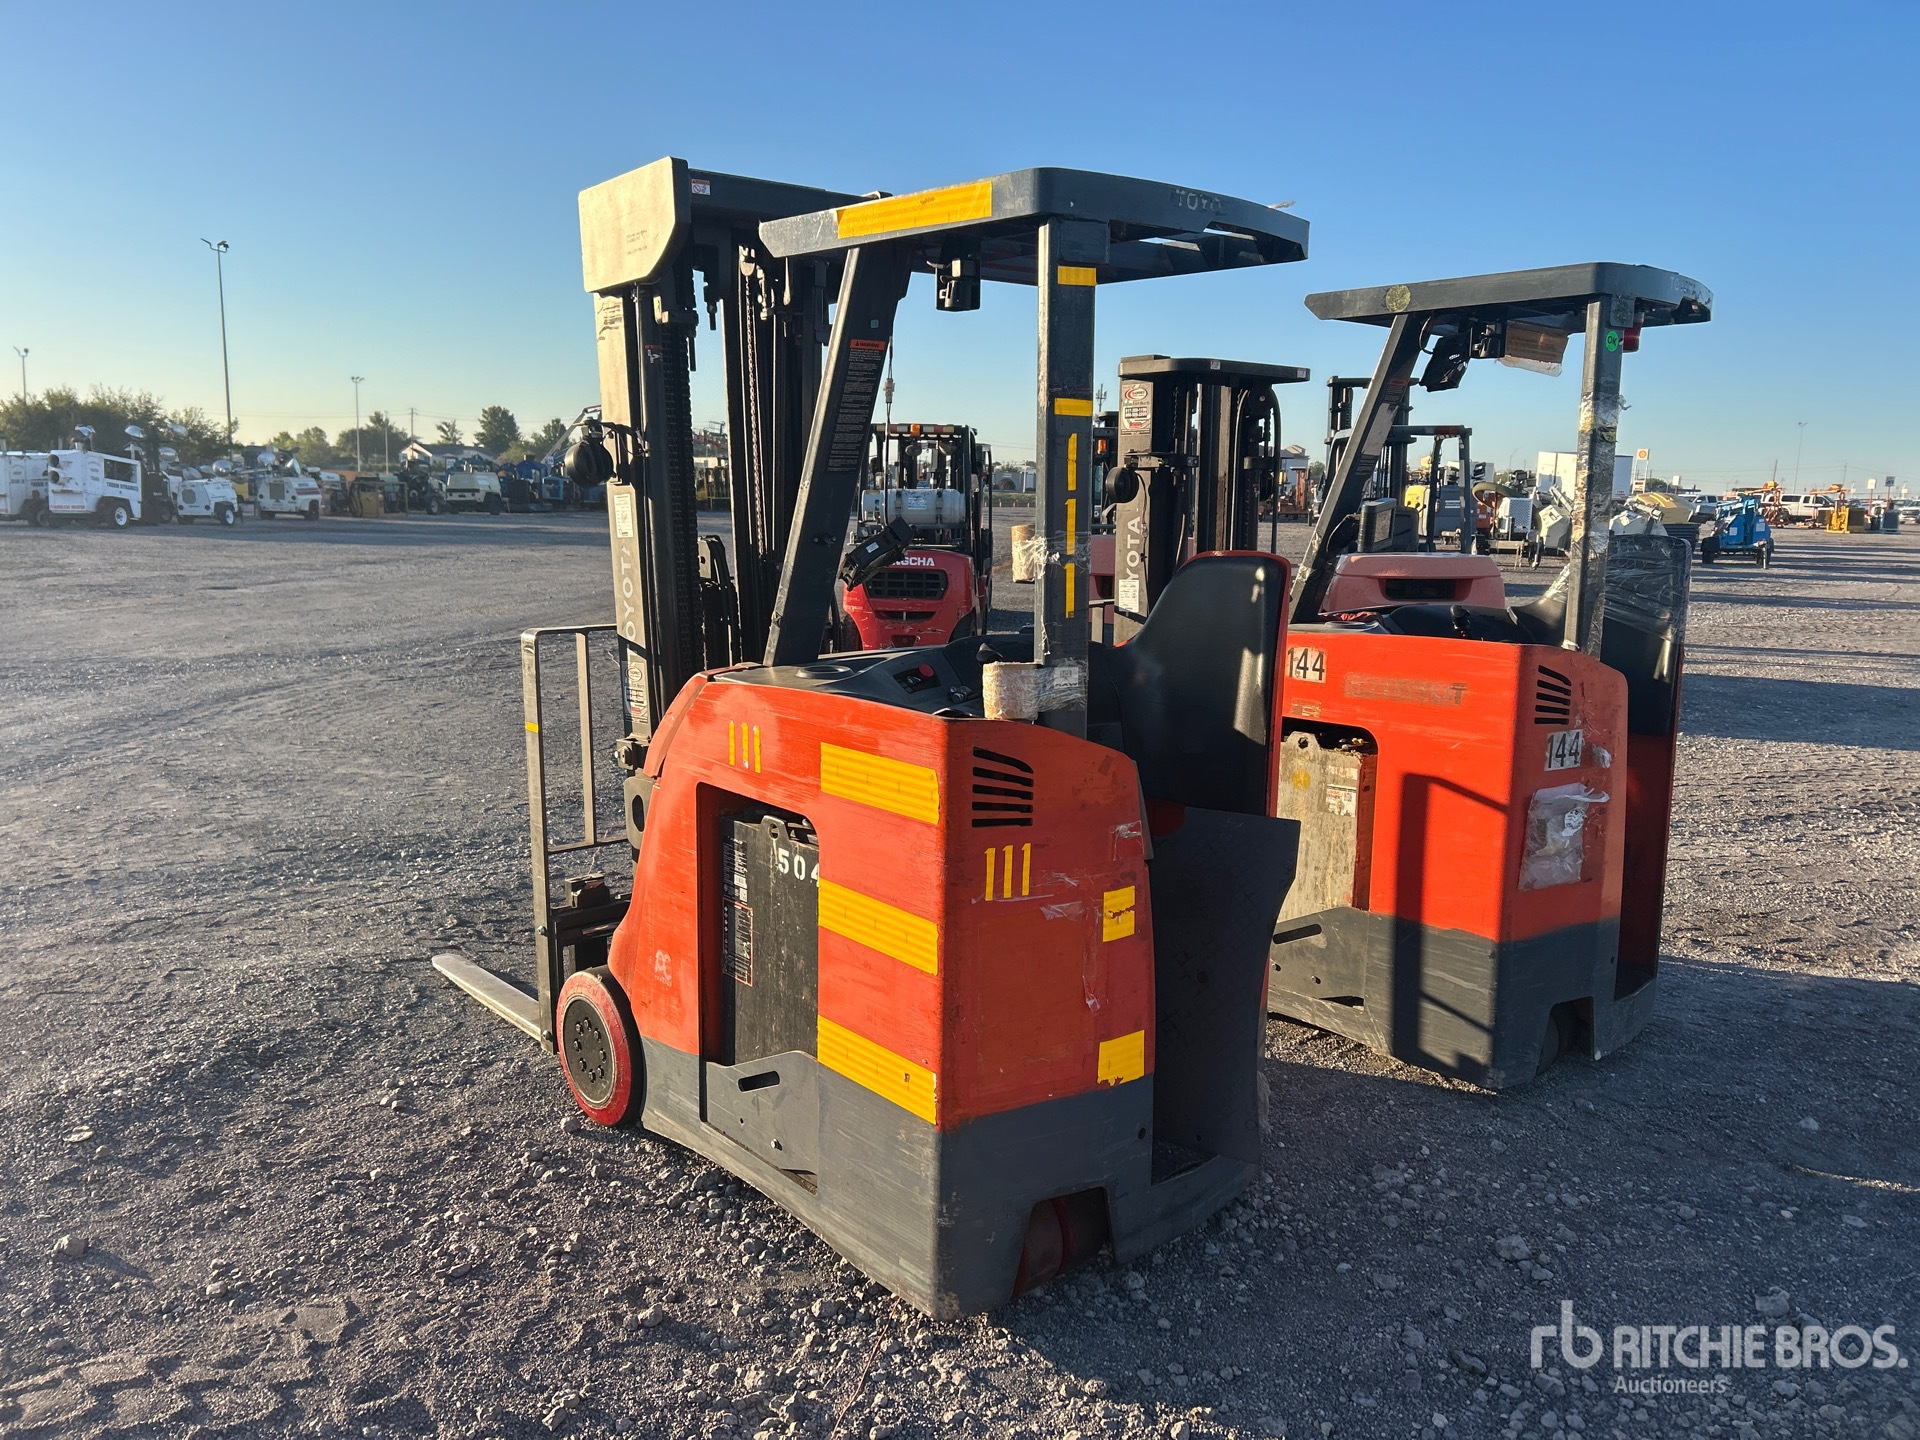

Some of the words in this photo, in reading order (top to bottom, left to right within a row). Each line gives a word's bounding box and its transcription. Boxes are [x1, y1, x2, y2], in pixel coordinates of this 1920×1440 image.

[1607, 335, 1618, 347] OK
[120, 483, 139, 492] DYNAMICS
[1287, 648, 1326, 681] 144
[729, 720, 762, 774] 111
[1547, 731, 1580, 769] 144
[778, 847, 820, 888] 504
[984, 842, 1033, 902] 111
